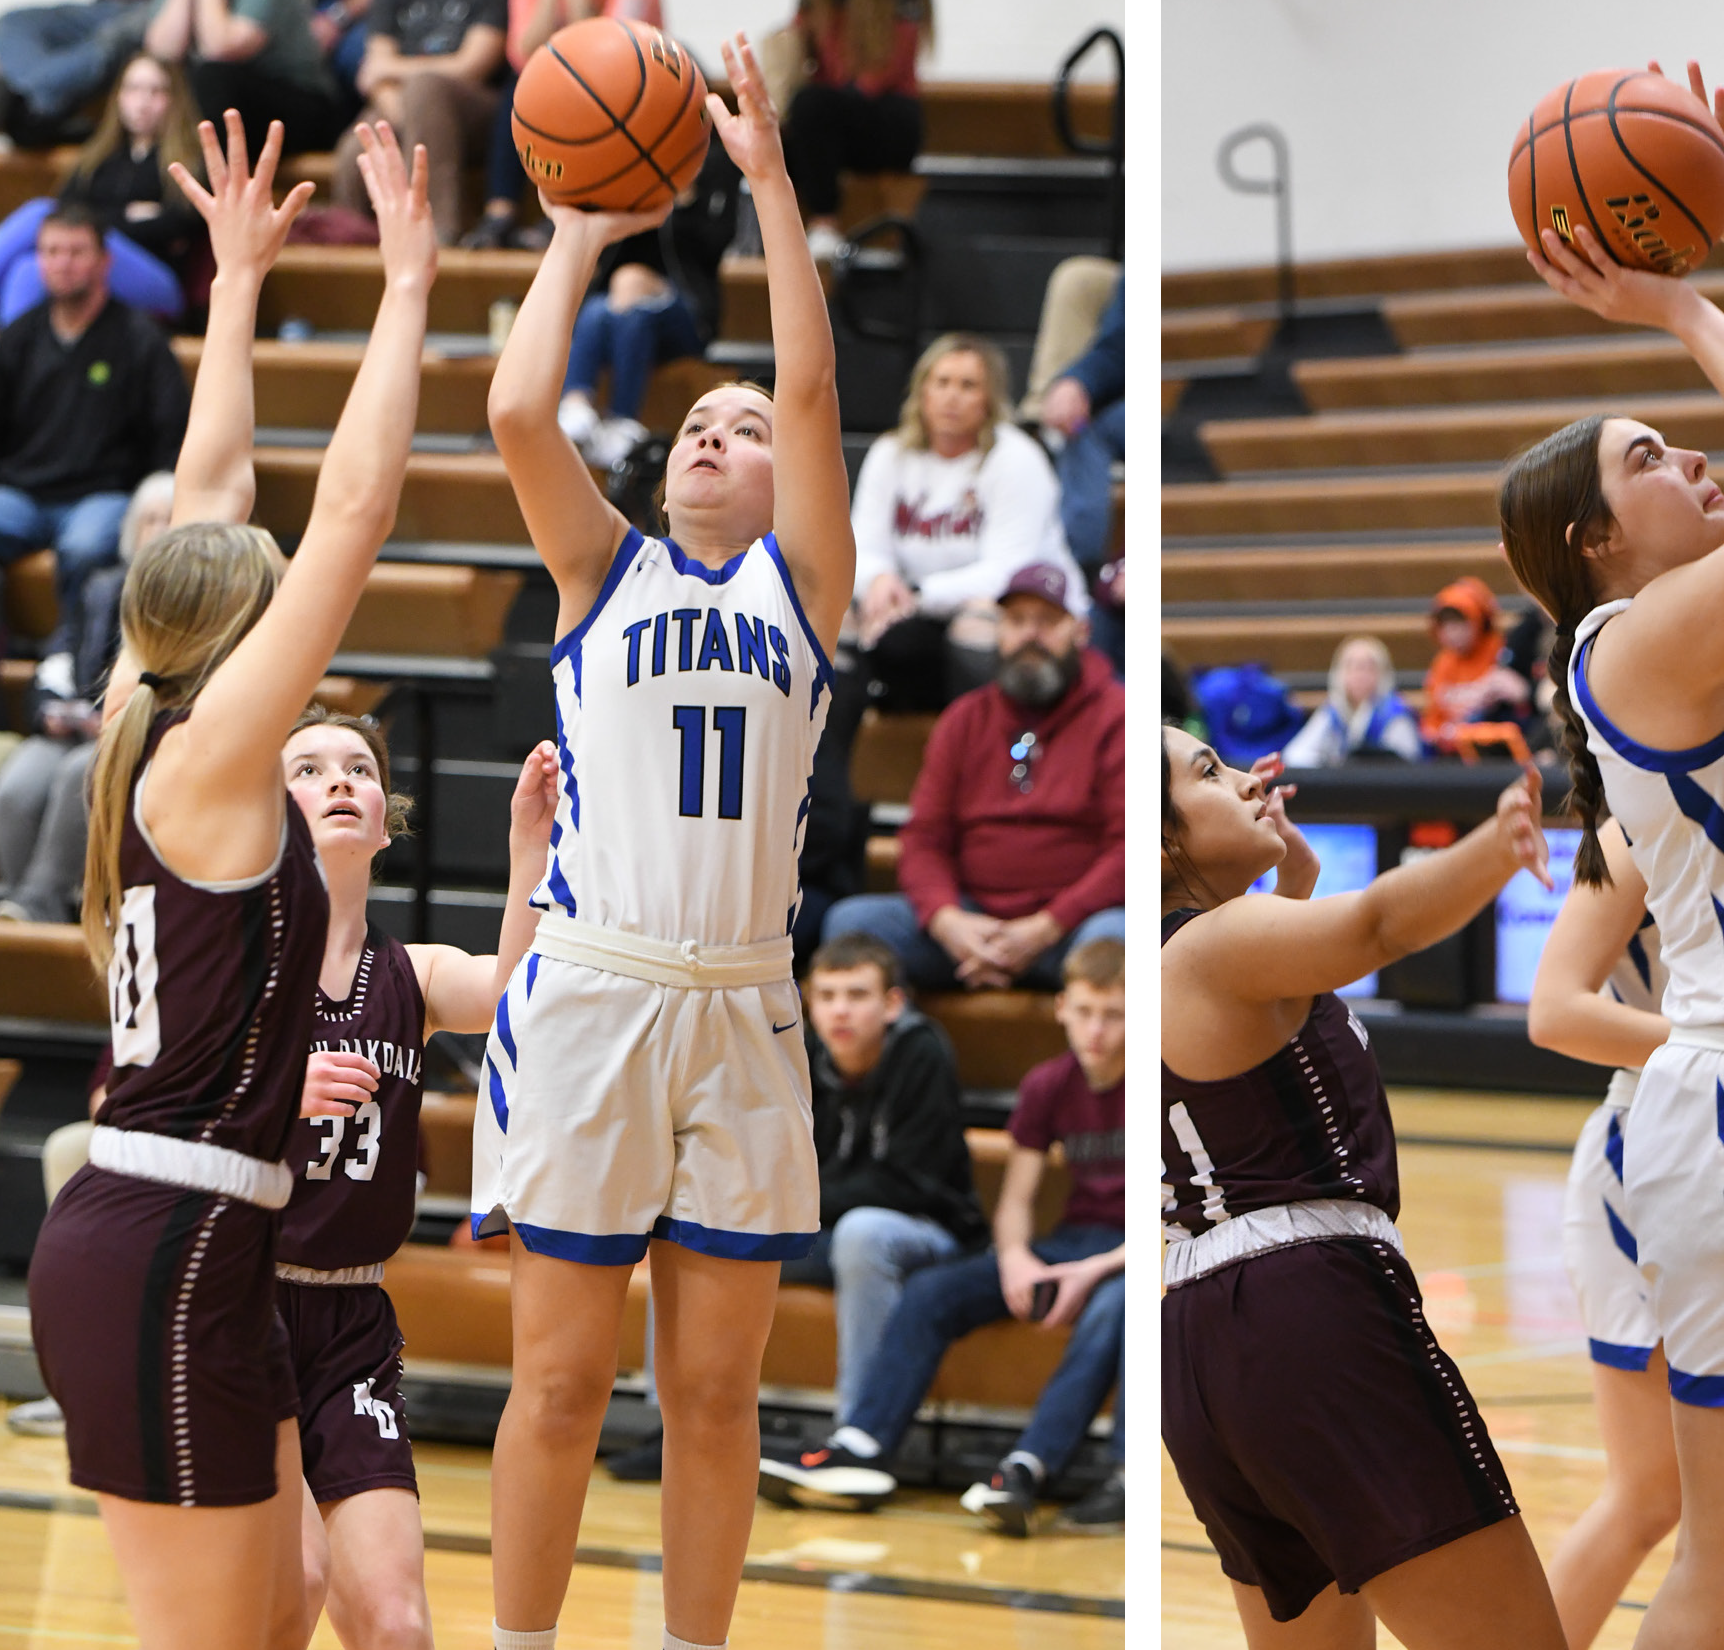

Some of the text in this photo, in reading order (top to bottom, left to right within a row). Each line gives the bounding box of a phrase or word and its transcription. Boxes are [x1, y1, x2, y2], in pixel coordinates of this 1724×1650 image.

[622, 607, 792, 698] TITANS
[672, 705, 747, 821] 11
[305, 1101, 381, 1181] 33
[1161, 1100, 1232, 1243] 1
